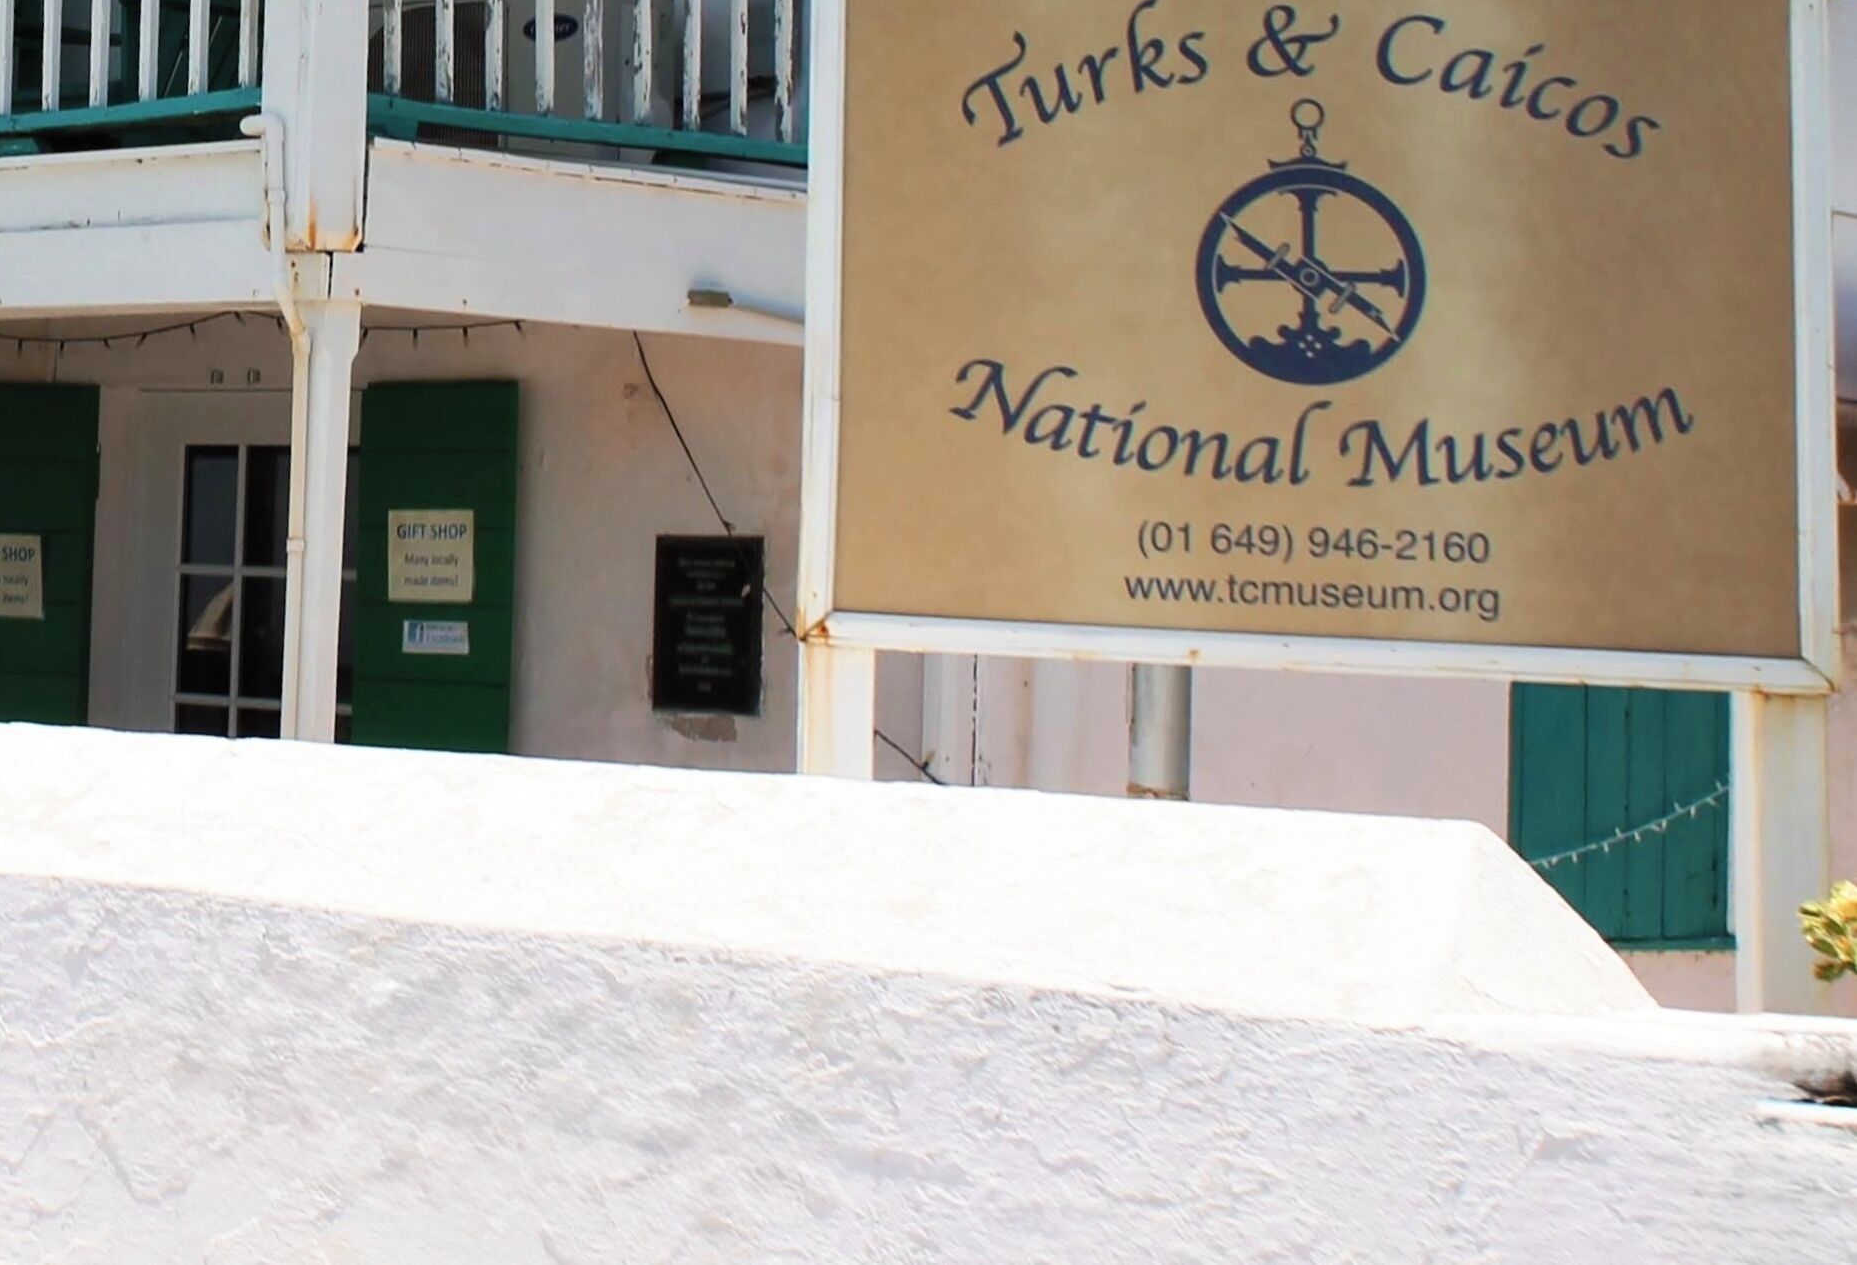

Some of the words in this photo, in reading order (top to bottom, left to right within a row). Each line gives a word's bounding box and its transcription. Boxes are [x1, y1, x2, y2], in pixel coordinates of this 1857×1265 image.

[1246, 4, 1339, 78] &
[1375, 14, 1660, 159] Caicos
[948, 358, 1332, 485] National
[1338, 386, 1694, 488] Museum
[2, 545, 36, 562] SHOP
[397, 523, 426, 540] GIFT
[430, 523, 468, 540] SHOP
[1136, 520, 1192, 560] (01
[1210, 522, 1294, 564] 649)
[1307, 526, 1490, 564] 946-2160
[1124, 574, 1500, 622] www.tcmuseum.org
